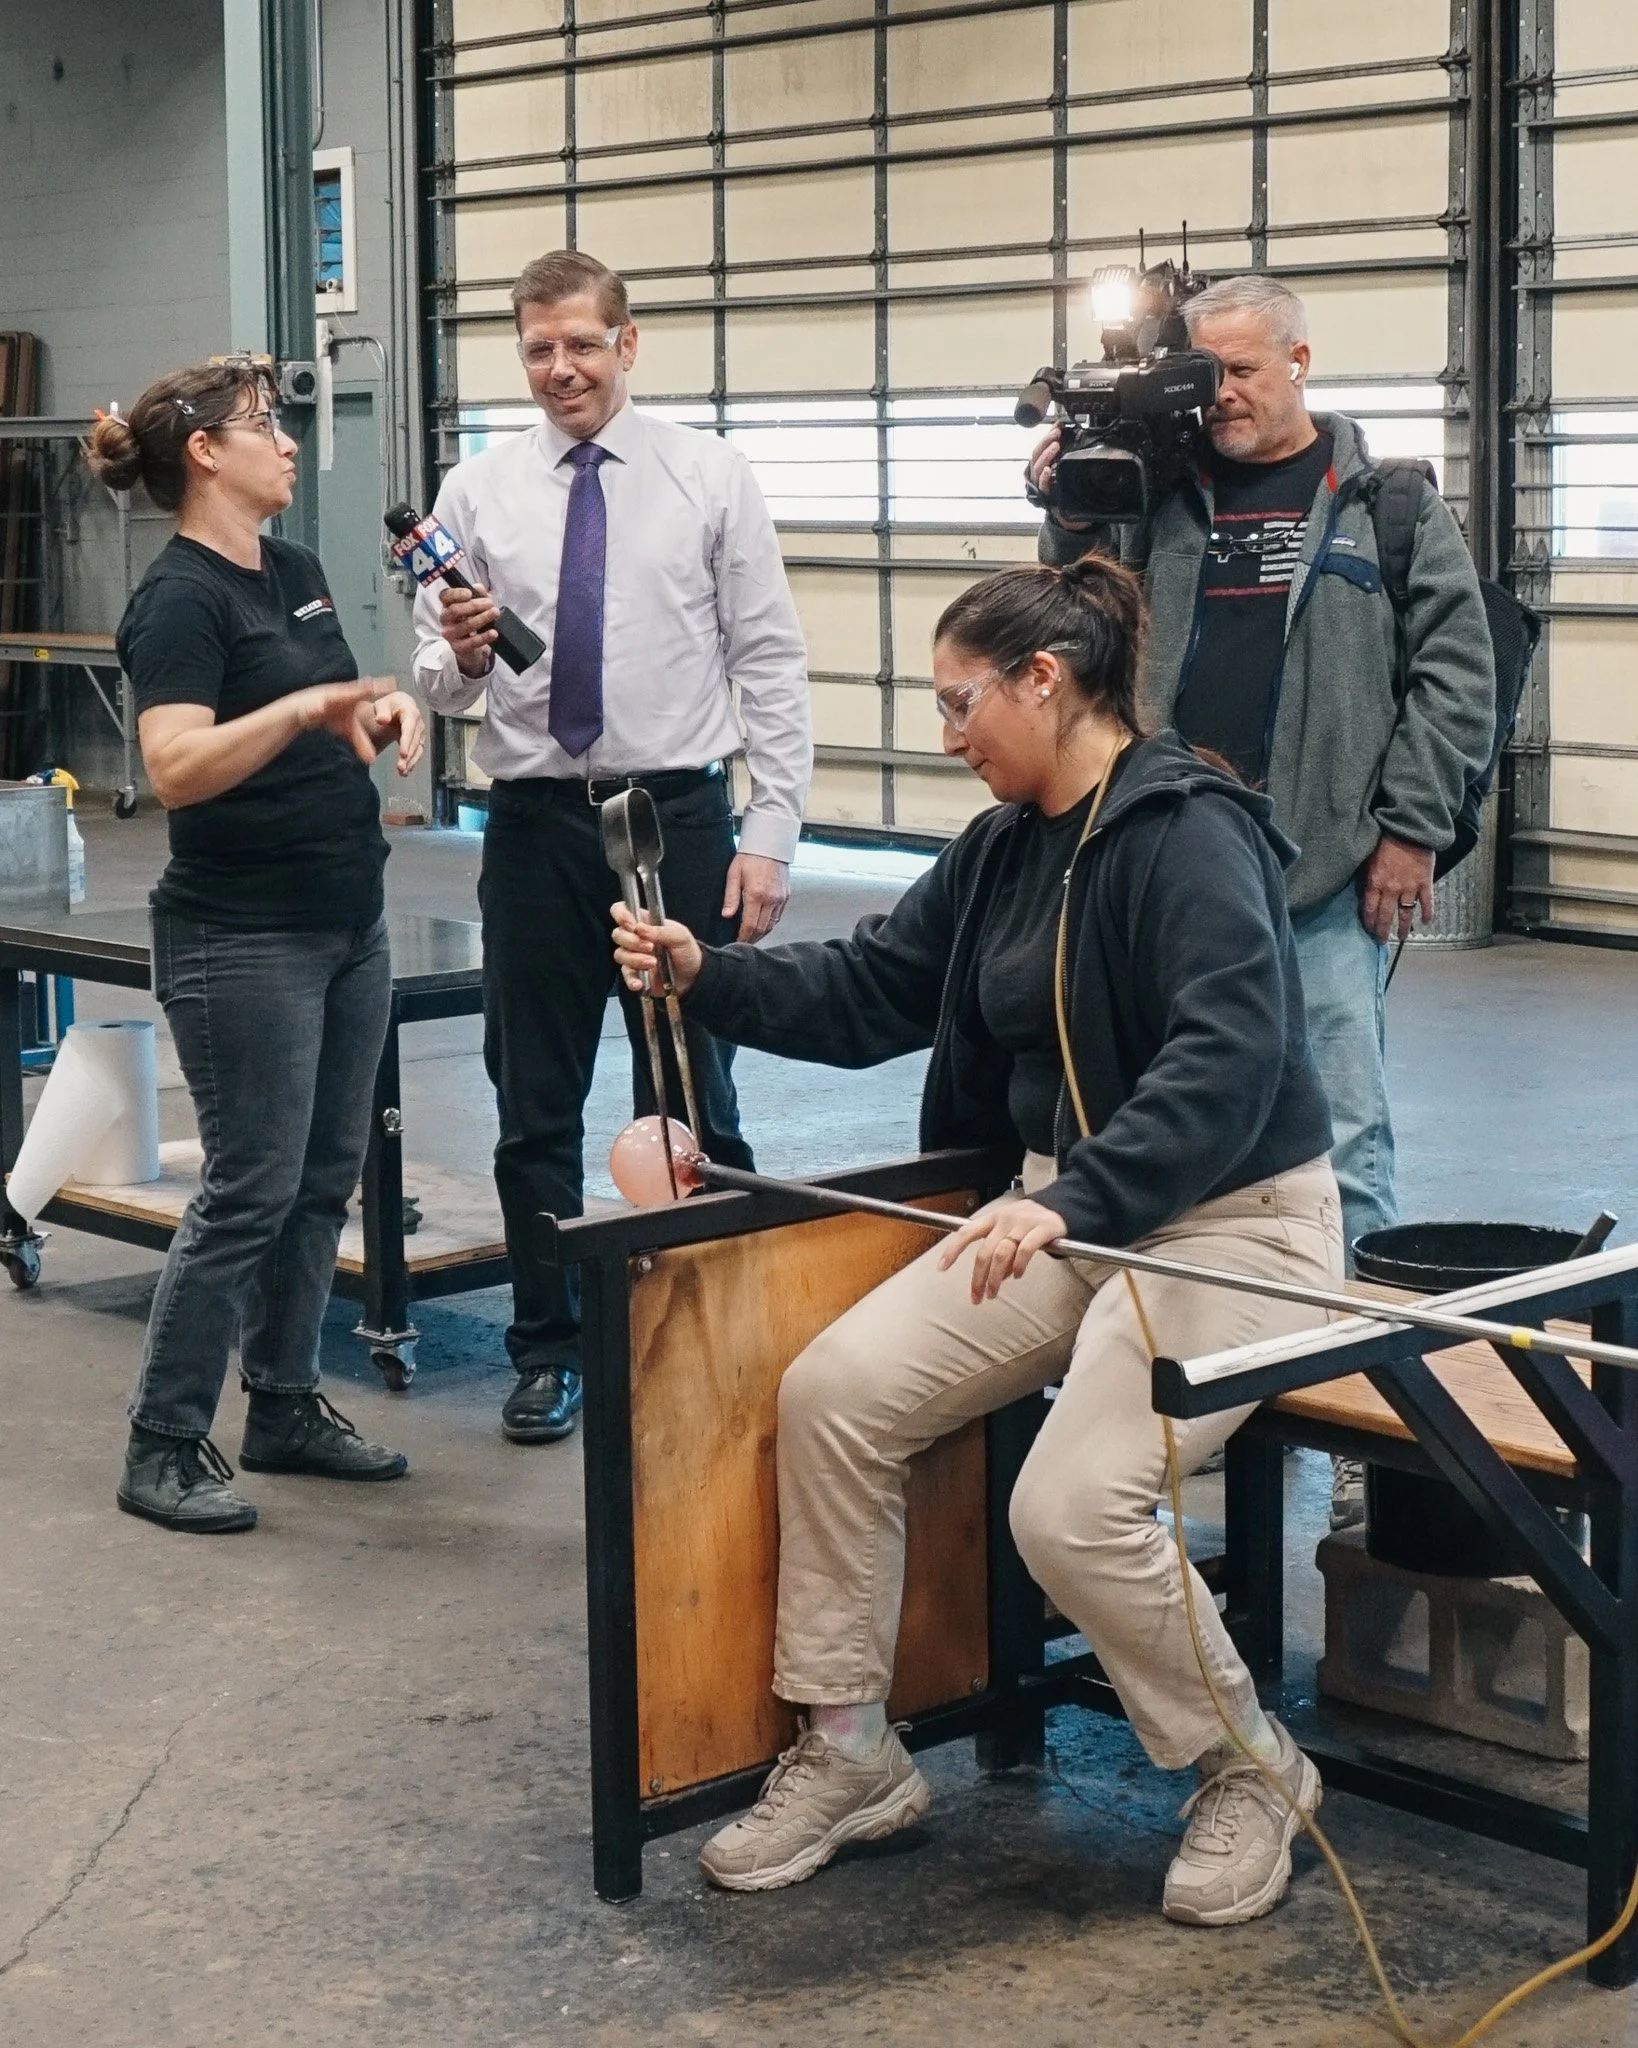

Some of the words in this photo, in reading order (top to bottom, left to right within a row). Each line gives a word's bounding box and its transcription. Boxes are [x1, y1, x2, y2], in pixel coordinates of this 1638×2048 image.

[415, 516, 439, 537] FOX
[393, 532, 419, 556] FOX
[434, 530, 456, 557] 4
[412, 547, 435, 576] 4
